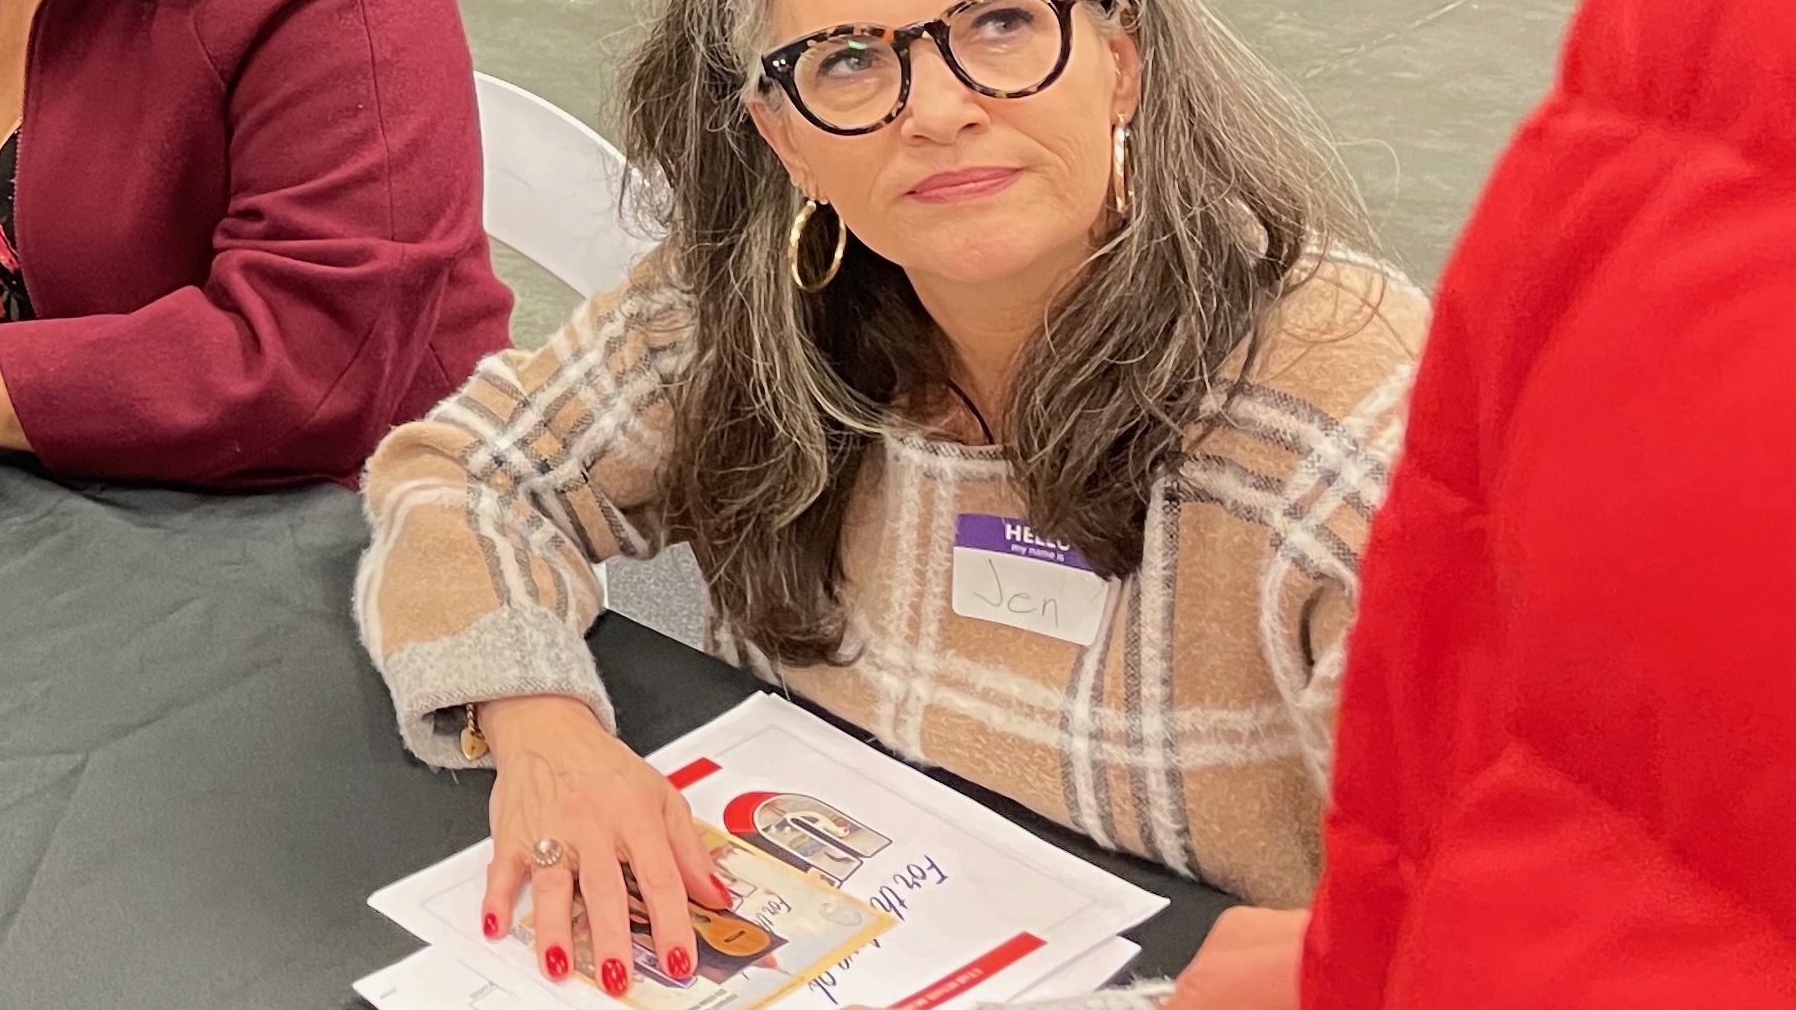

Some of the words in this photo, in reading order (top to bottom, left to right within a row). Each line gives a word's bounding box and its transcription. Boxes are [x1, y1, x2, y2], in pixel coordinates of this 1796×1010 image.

[972, 557, 1059, 628] Jen
[892, 854, 948, 890] For
[869, 885, 908, 921] th
